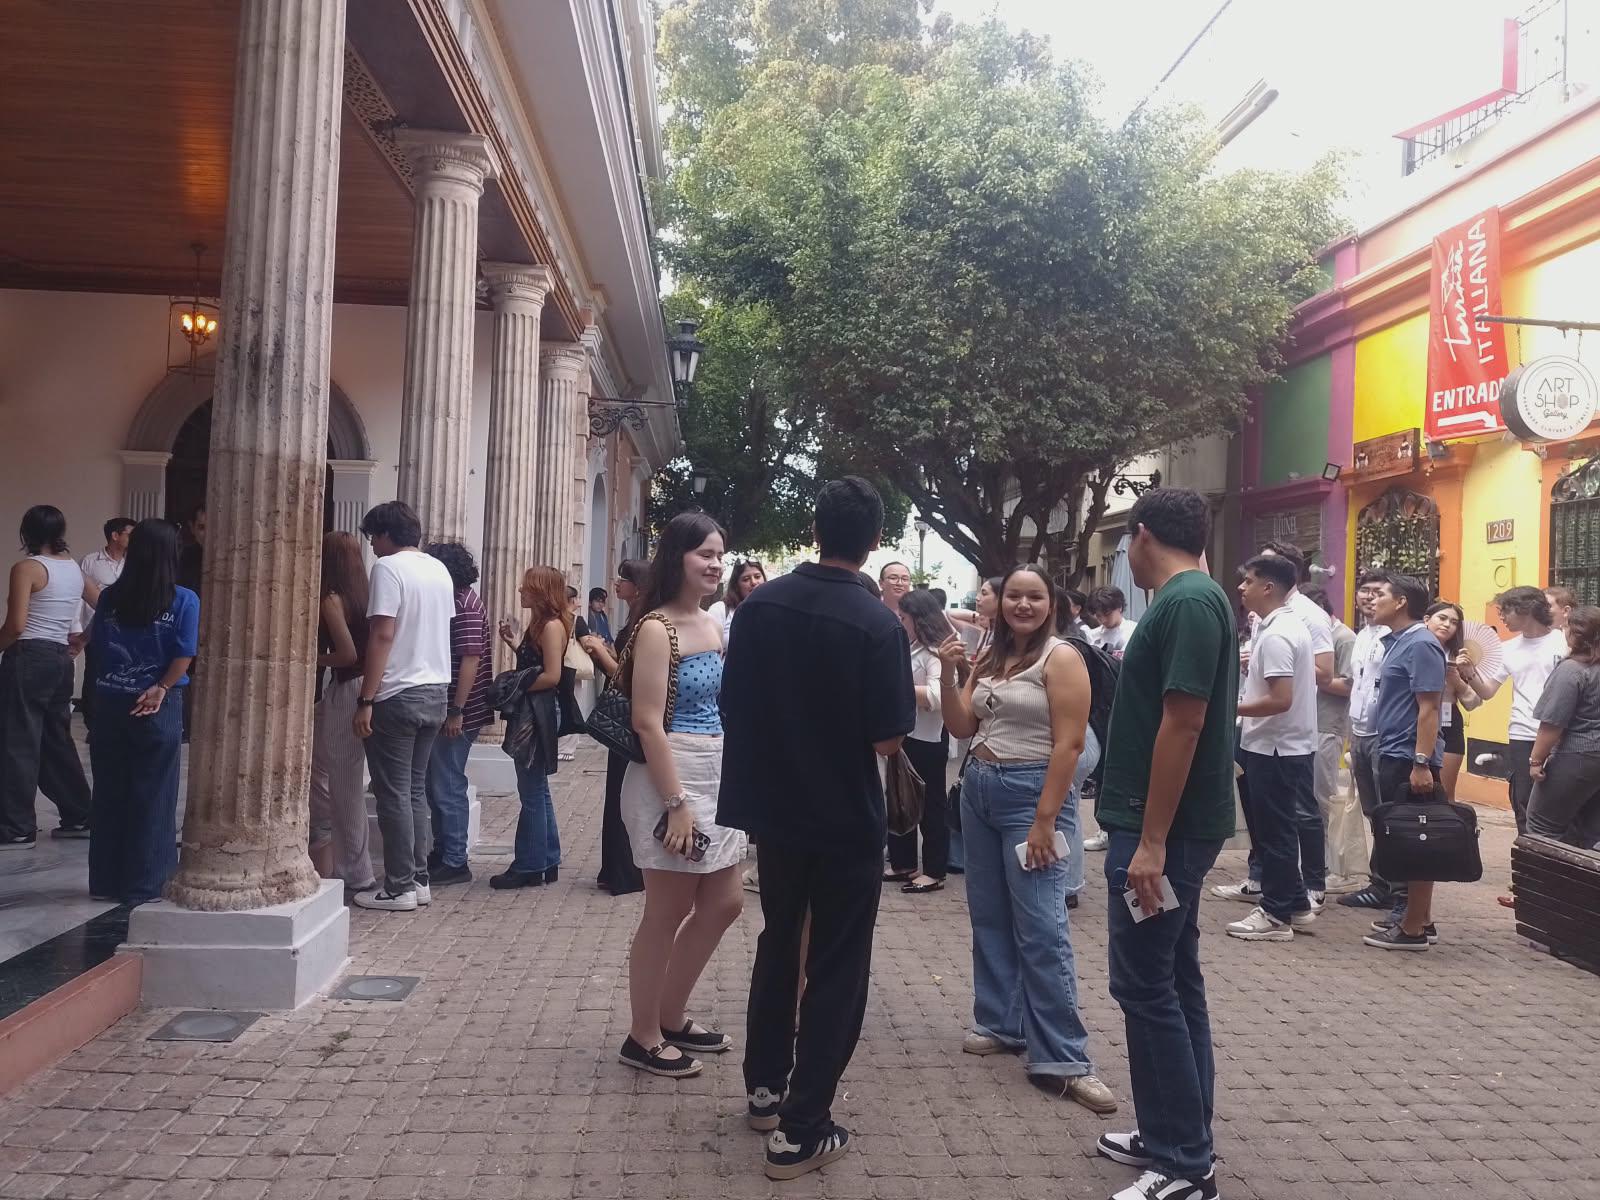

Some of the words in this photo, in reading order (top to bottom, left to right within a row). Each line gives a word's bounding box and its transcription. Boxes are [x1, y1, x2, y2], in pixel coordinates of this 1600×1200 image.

[1468, 218, 1494, 364] ITALIANA
[1538, 377, 1574, 393] ART
[1534, 393, 1580, 409] SHOP
[1543, 408, 1568, 420] Gallery
[1487, 522, 1512, 540] 1209
